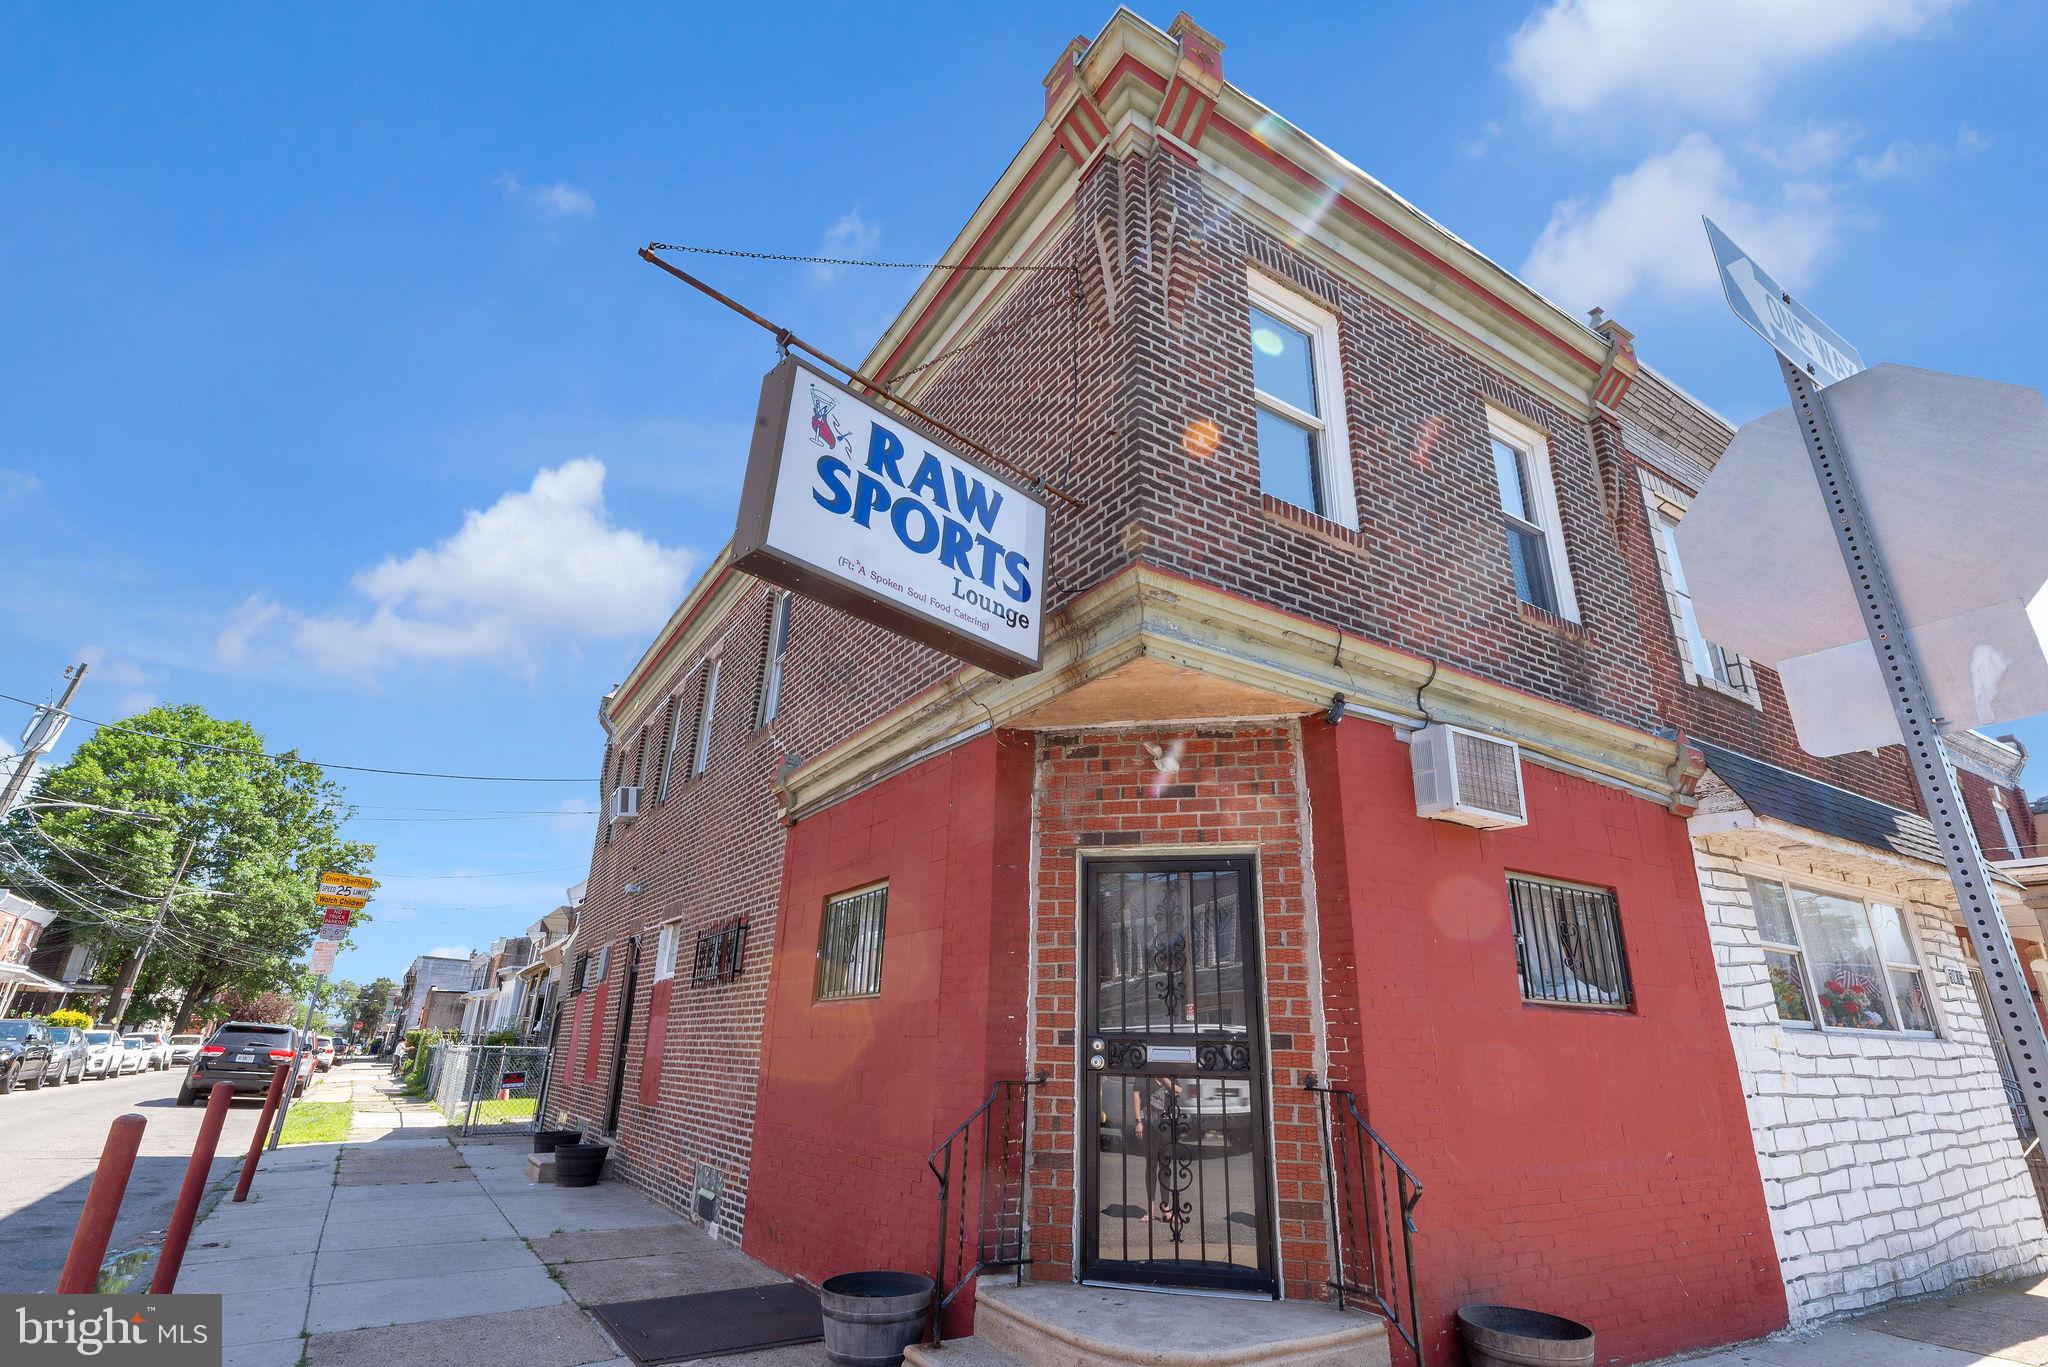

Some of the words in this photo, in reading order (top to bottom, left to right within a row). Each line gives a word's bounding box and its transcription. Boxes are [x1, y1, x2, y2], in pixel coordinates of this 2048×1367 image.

[1765, 292, 1813, 356] ONE
[865, 420, 1003, 534] RAW
[812, 455, 1032, 603] SPORTS
[870, 571, 904, 592] Spoken
[907, 587, 927, 603] Soul
[930, 597, 951, 613] Food
[954, 608, 990, 631] Catering)
[952, 577, 1030, 629] Lounge
[319, 896, 338, 904] Watch
[339, 898, 364, 907] Children
[321, 885, 336, 893] SPEED
[336, 885, 352, 896] 25
[325, 875, 340, 883] Drive
